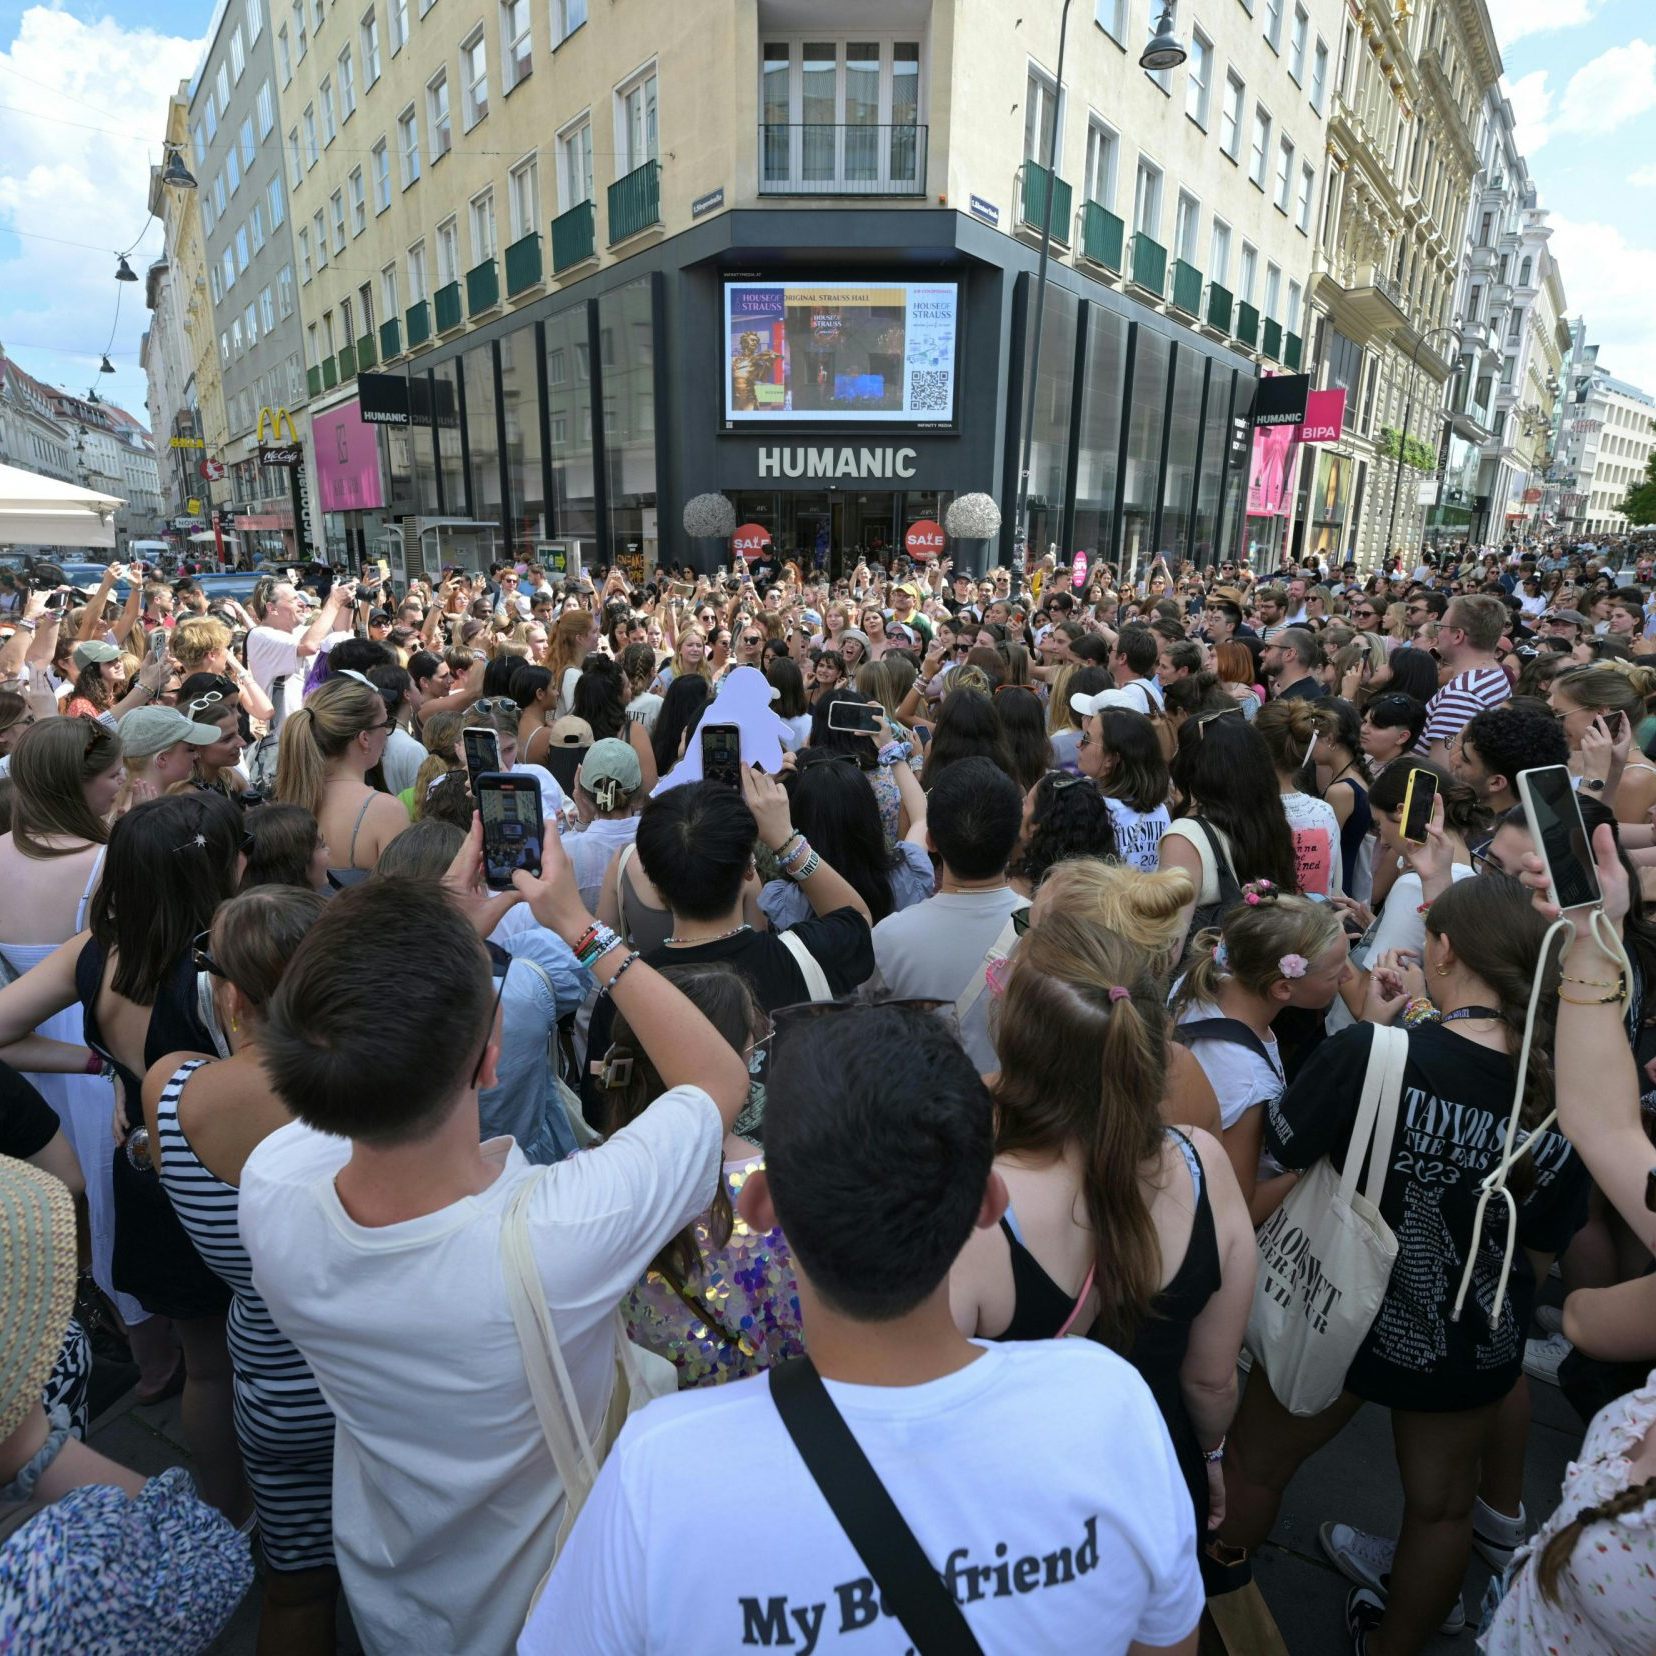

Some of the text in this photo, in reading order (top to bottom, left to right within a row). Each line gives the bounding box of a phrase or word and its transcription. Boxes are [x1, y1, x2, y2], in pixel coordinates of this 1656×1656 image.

[742, 302, 782, 311] STRAUSS
[912, 311, 952, 319] STRAUSS
[364, 411, 407, 422] HUMANIC
[1256, 412, 1301, 424] HUMANIC
[1302, 426, 1336, 439] BIPA
[757, 447, 917, 479] HUMANIC
[297, 459, 313, 544] McDonald
[907, 532, 944, 546] SALE
[800, 851, 819, 877] TAYLO
[1140, 854, 1159, 866] 202
[1404, 1086, 1494, 1150] TAYLOR
[1403, 1127, 1446, 1156] THE
[738, 1515, 1101, 1656] My Bfriend
